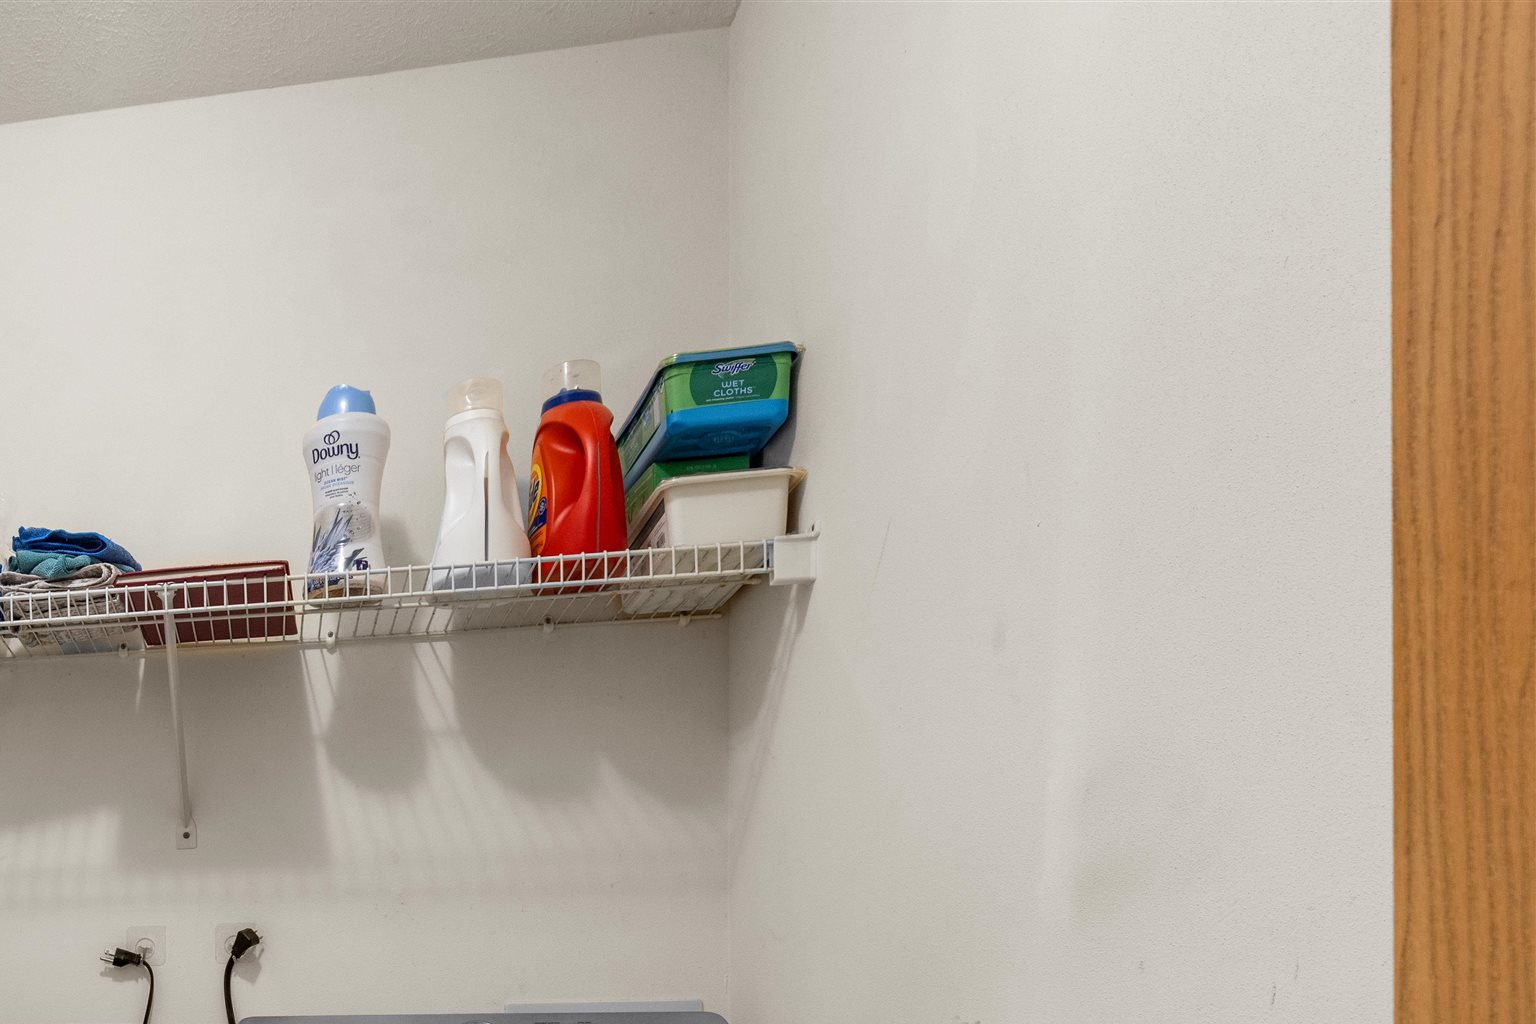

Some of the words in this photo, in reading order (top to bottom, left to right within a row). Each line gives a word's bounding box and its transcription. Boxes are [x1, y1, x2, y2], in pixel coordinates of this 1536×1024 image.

[711, 362, 756, 376] Swiffer
[721, 379, 745, 388] WET
[713, 386, 753, 397] CLOTHS
[312, 443, 359, 464] Downy
[313, 468, 330, 483] ight
